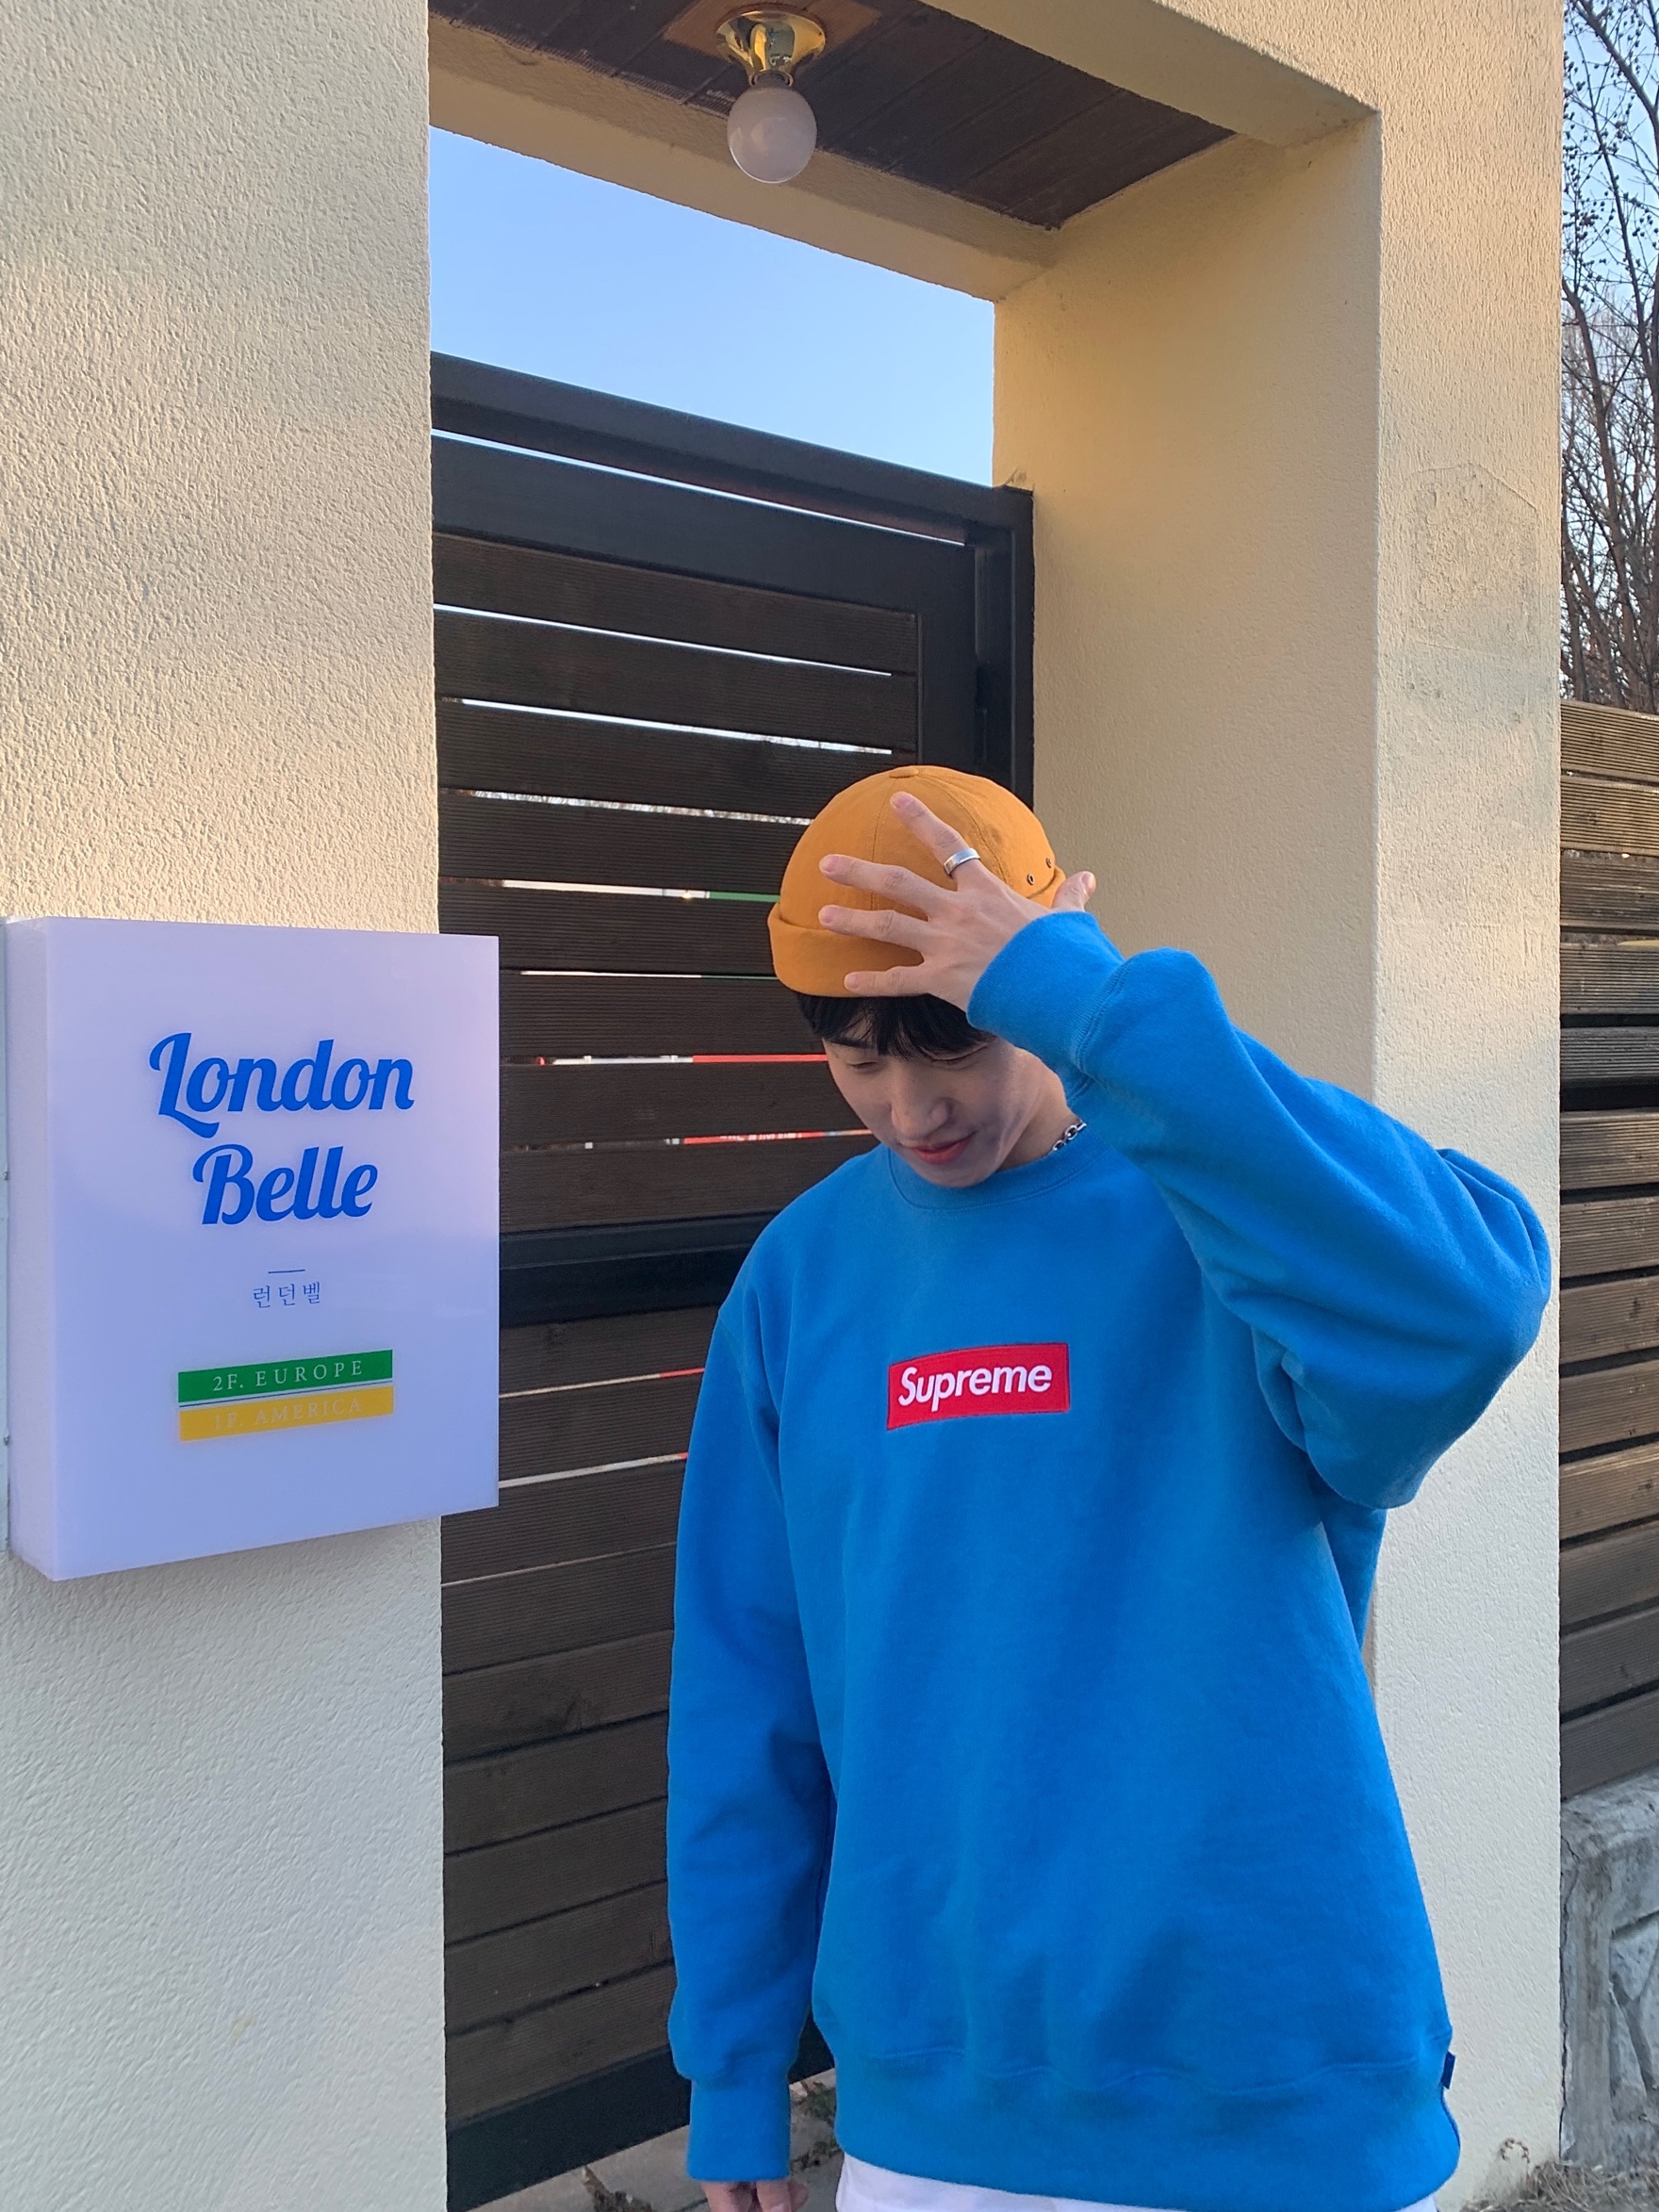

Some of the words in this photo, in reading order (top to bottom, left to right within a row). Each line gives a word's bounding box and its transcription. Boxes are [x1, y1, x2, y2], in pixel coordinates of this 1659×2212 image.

[149, 1032, 415, 1139] London
[192, 1143, 378, 1225] Belle
[253, 1281, 320, 1308] 런던벨
[212, 1373, 243, 1392] 2F.
[255, 1360, 362, 1387] EUROPE
[897, 1364, 1052, 1412] Supreme
[254, 1399, 362, 1426] AMERICA
